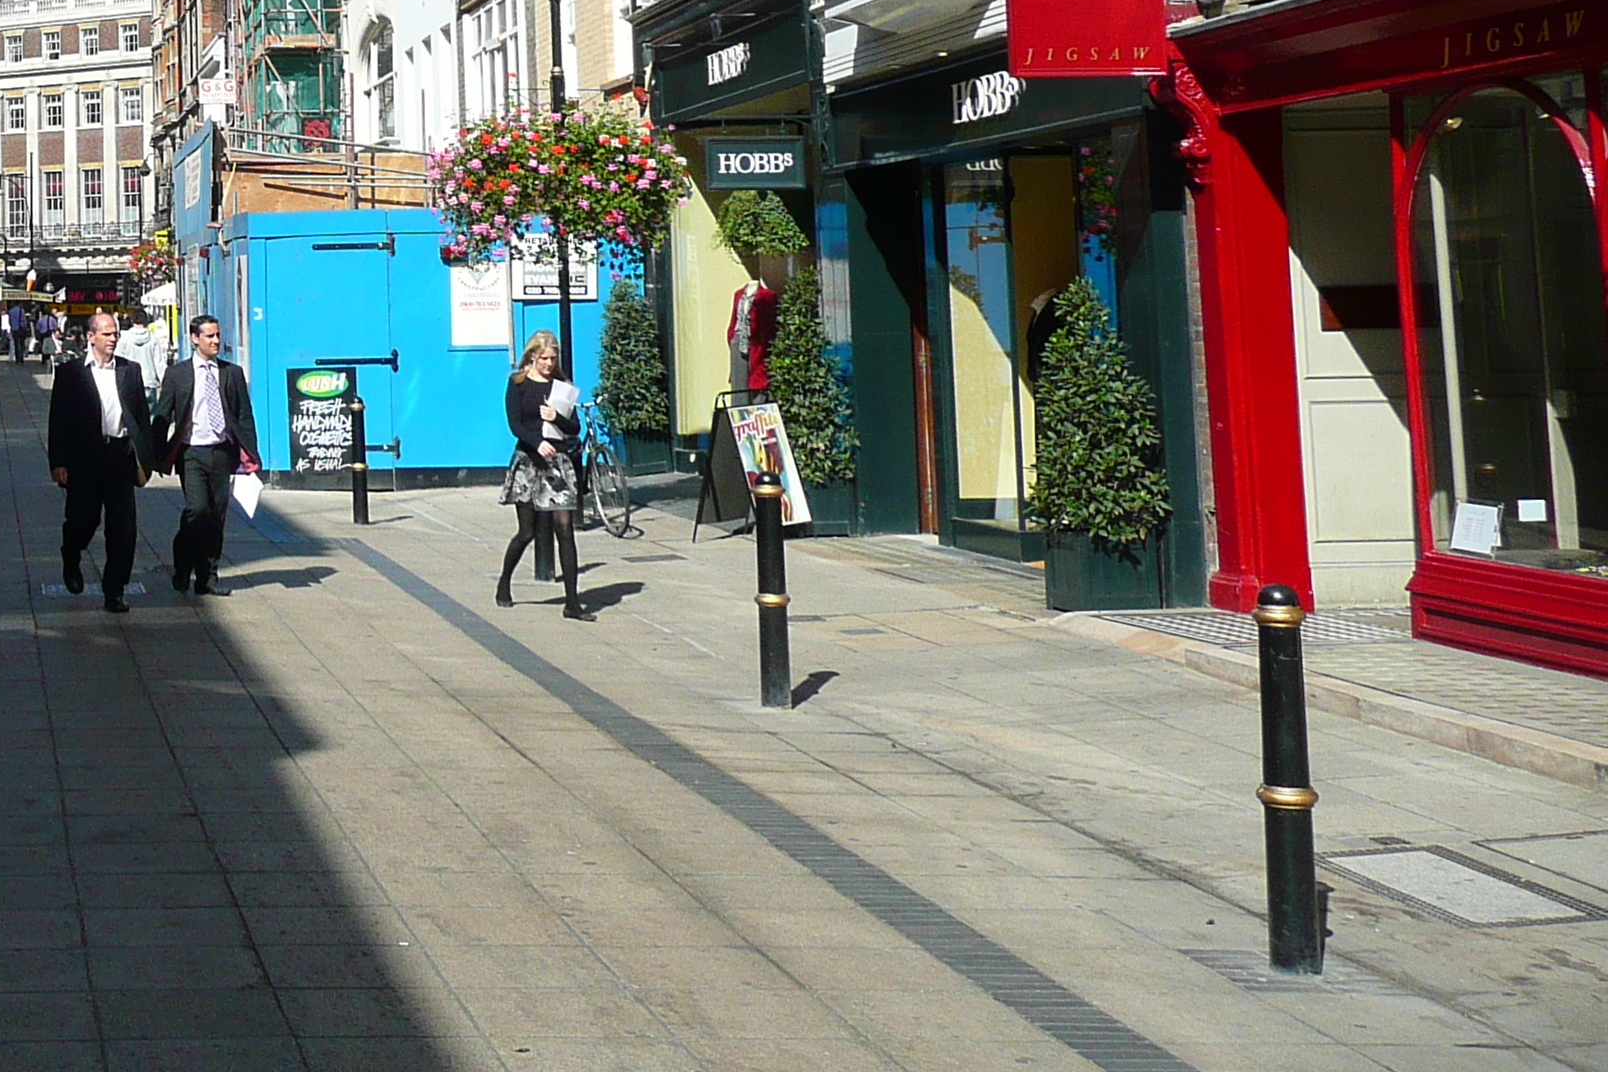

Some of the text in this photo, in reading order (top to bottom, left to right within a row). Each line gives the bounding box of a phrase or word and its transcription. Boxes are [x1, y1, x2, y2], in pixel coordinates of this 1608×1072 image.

[1440, 10, 1585, 68] JIGSAW
[1023, 47, 1150, 65] JIGSAW
[201, 80, 234, 92] G & G
[301, 372, 347, 391] LUSH
[299, 397, 347, 416] FRESH
[296, 457, 352, 473] AS USUAL
